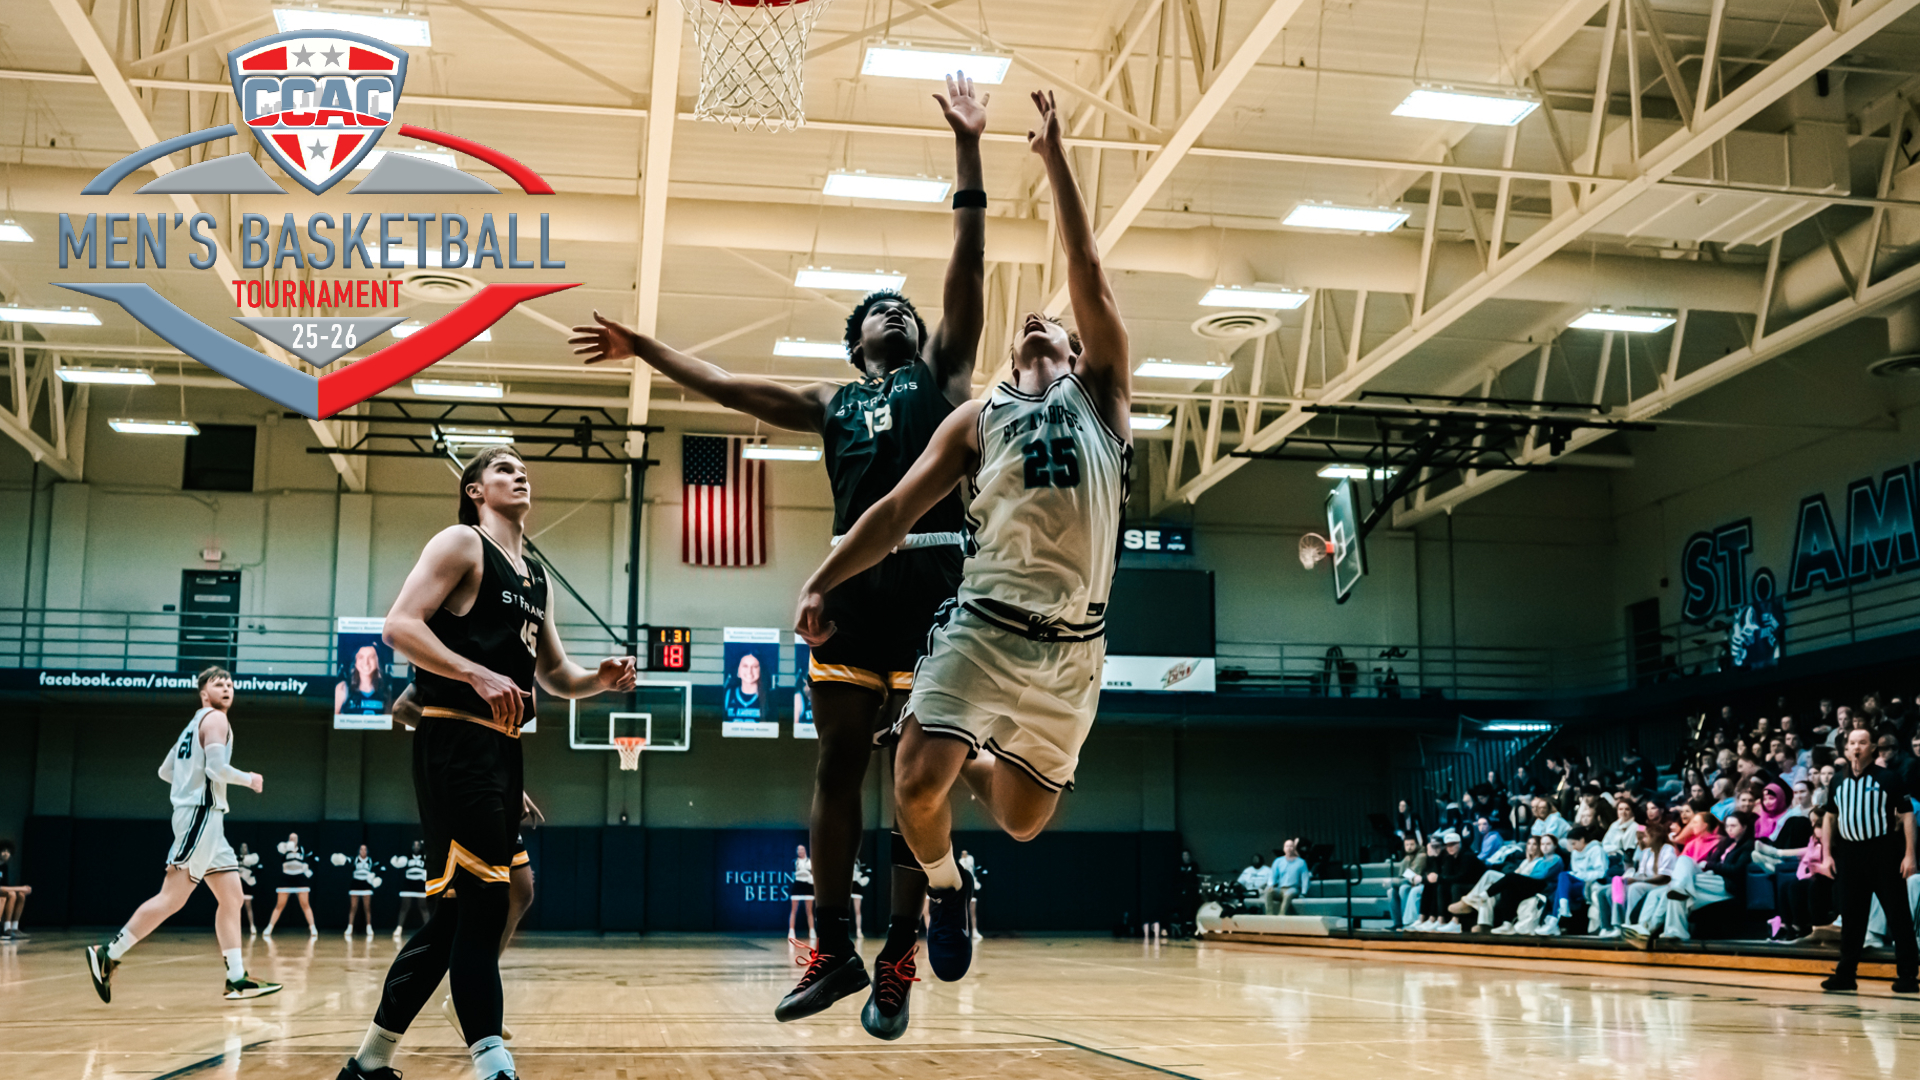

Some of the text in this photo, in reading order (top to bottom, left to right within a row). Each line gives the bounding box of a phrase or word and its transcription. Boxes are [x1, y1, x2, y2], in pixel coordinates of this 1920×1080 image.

[864, 404, 893, 439] 13
[1021, 438, 1081, 489] 25
[1682, 461, 1920, 626] ST. AM
[501, 590, 519, 604] ST
[663, 644, 684, 668] 18
[745, 885, 790, 901] BEES
